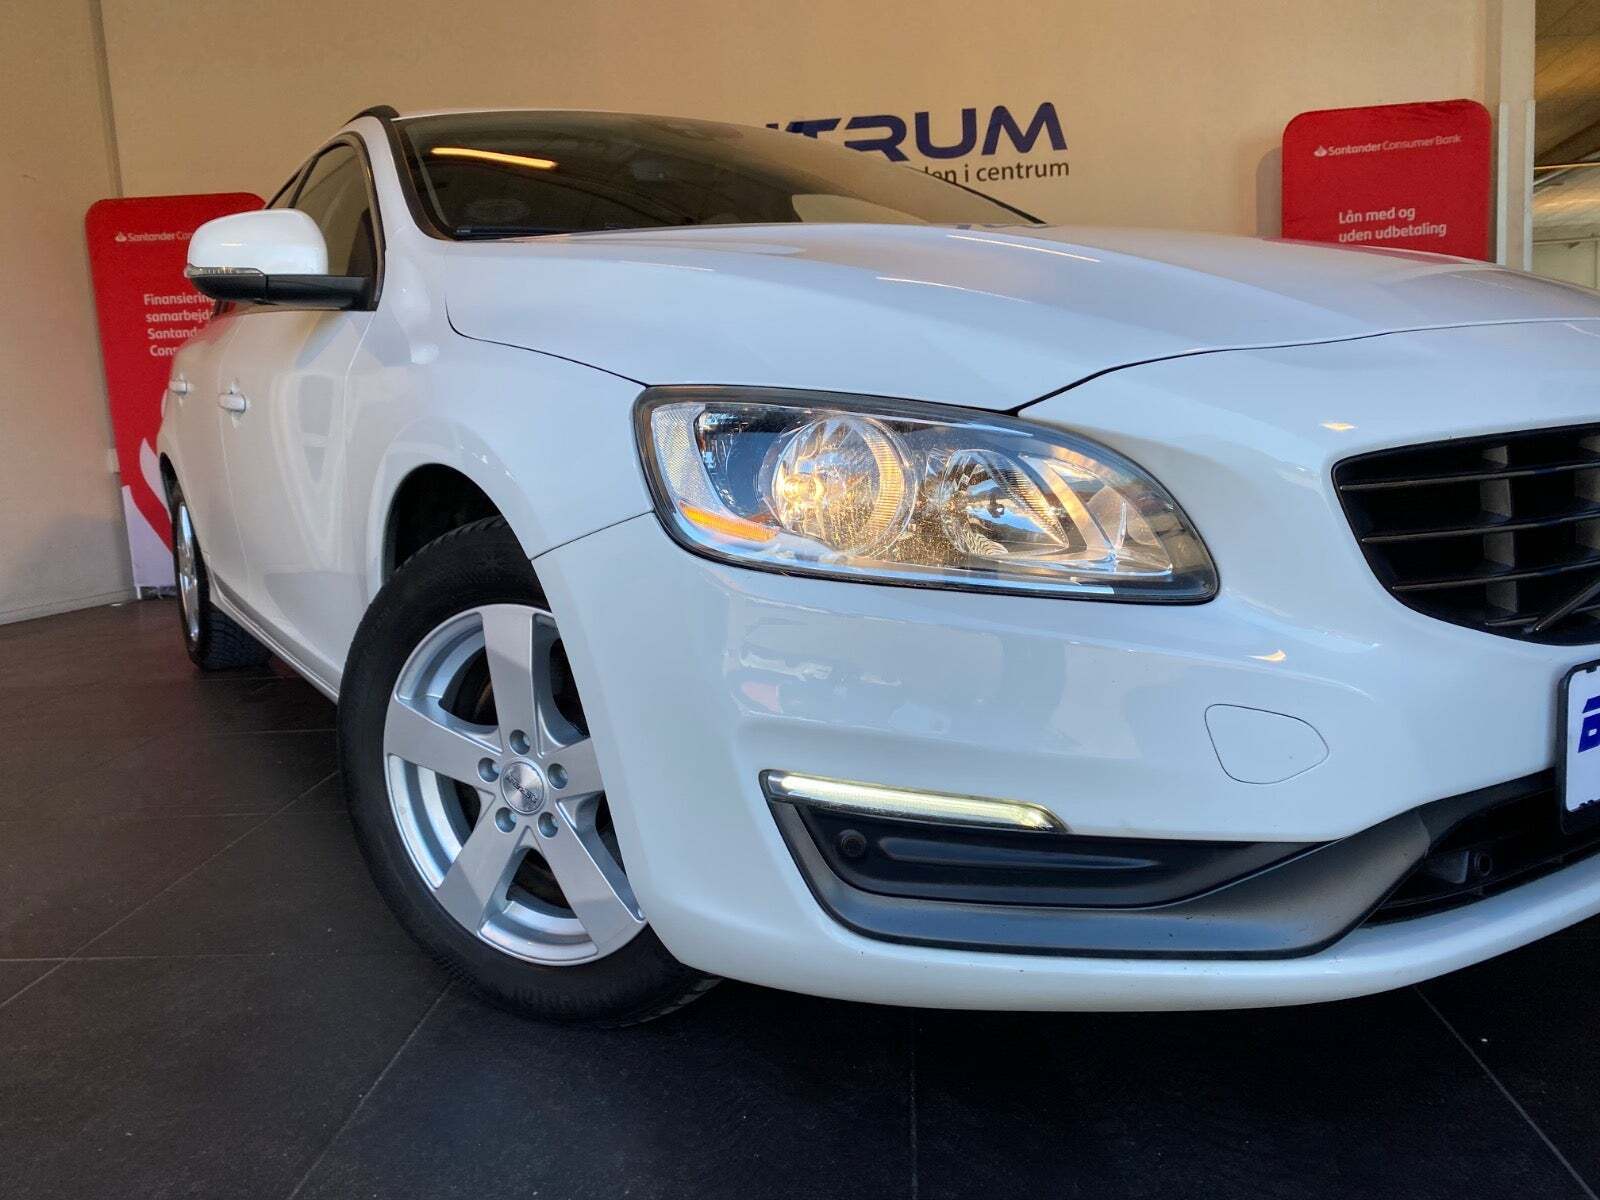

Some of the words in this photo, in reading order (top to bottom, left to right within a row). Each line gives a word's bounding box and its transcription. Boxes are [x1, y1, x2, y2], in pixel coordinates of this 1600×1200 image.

[766, 102, 1068, 162] TRUM
[1328, 141, 1381, 156] Santander
[1382, 138, 1434, 151] Consumer
[1435, 134, 1461, 146] Bank
[964, 164, 969, 182] i
[976, 161, 1069, 182] centrum
[1339, 209, 1362, 224] Lån
[1366, 207, 1396, 221] med
[1398, 207, 1415, 221] og
[127, 231, 175, 242] Santander
[1339, 229, 1371, 242] uden
[1376, 222, 1446, 237] udbetaling
[145, 309, 214, 323] samarbejd
